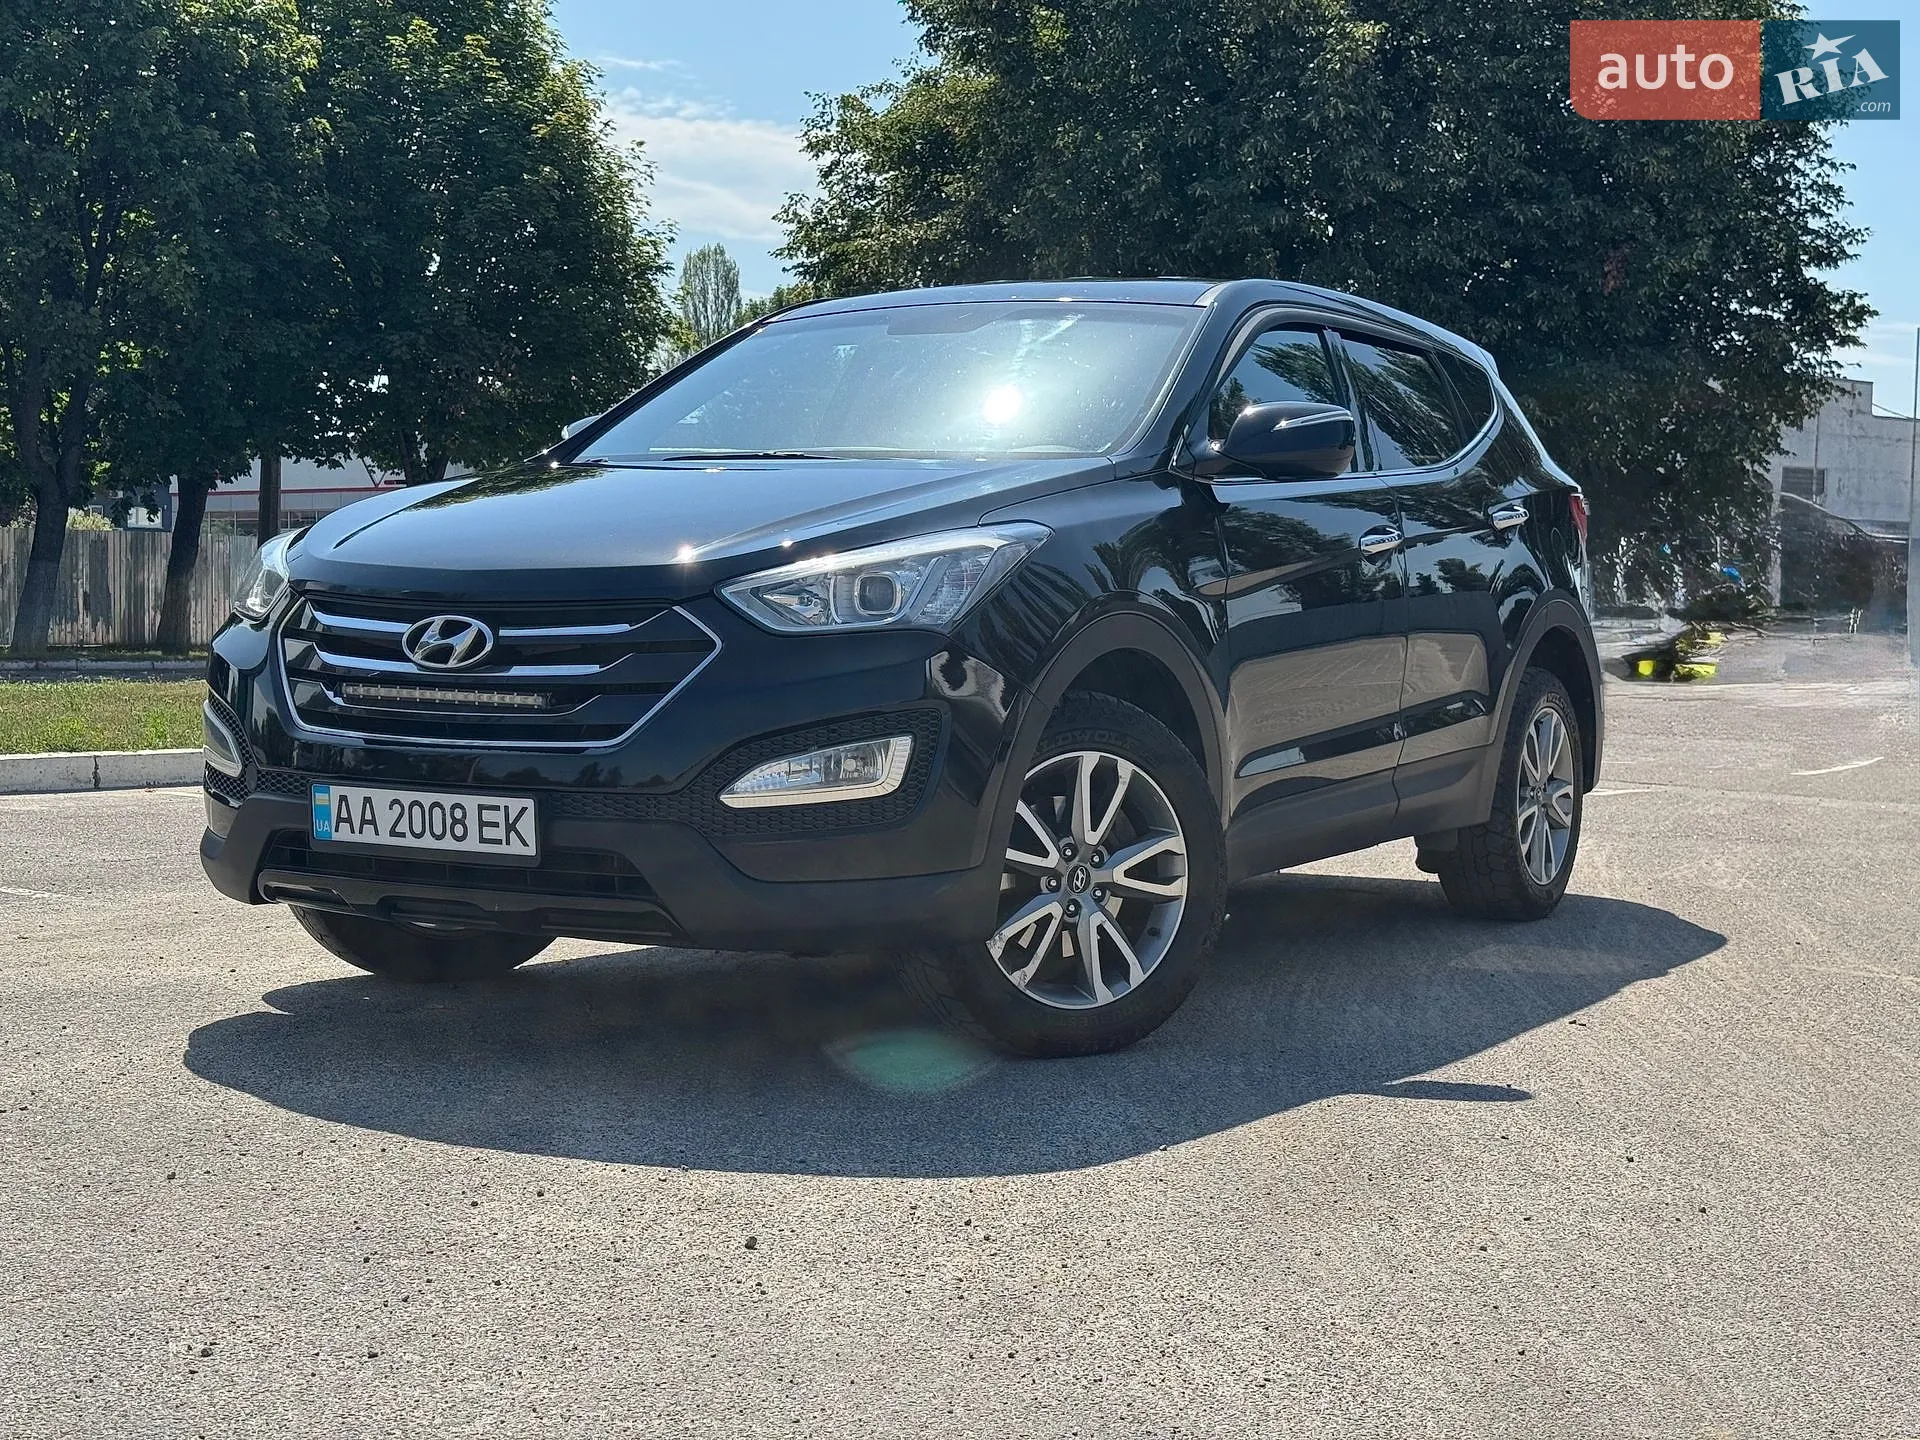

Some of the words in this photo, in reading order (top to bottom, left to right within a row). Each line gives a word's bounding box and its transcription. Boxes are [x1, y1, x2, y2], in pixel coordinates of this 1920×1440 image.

[315, 819, 331, 833] UA
[334, 794, 380, 836] AA
[388, 798, 469, 842] 2008
[477, 803, 530, 847] EK
